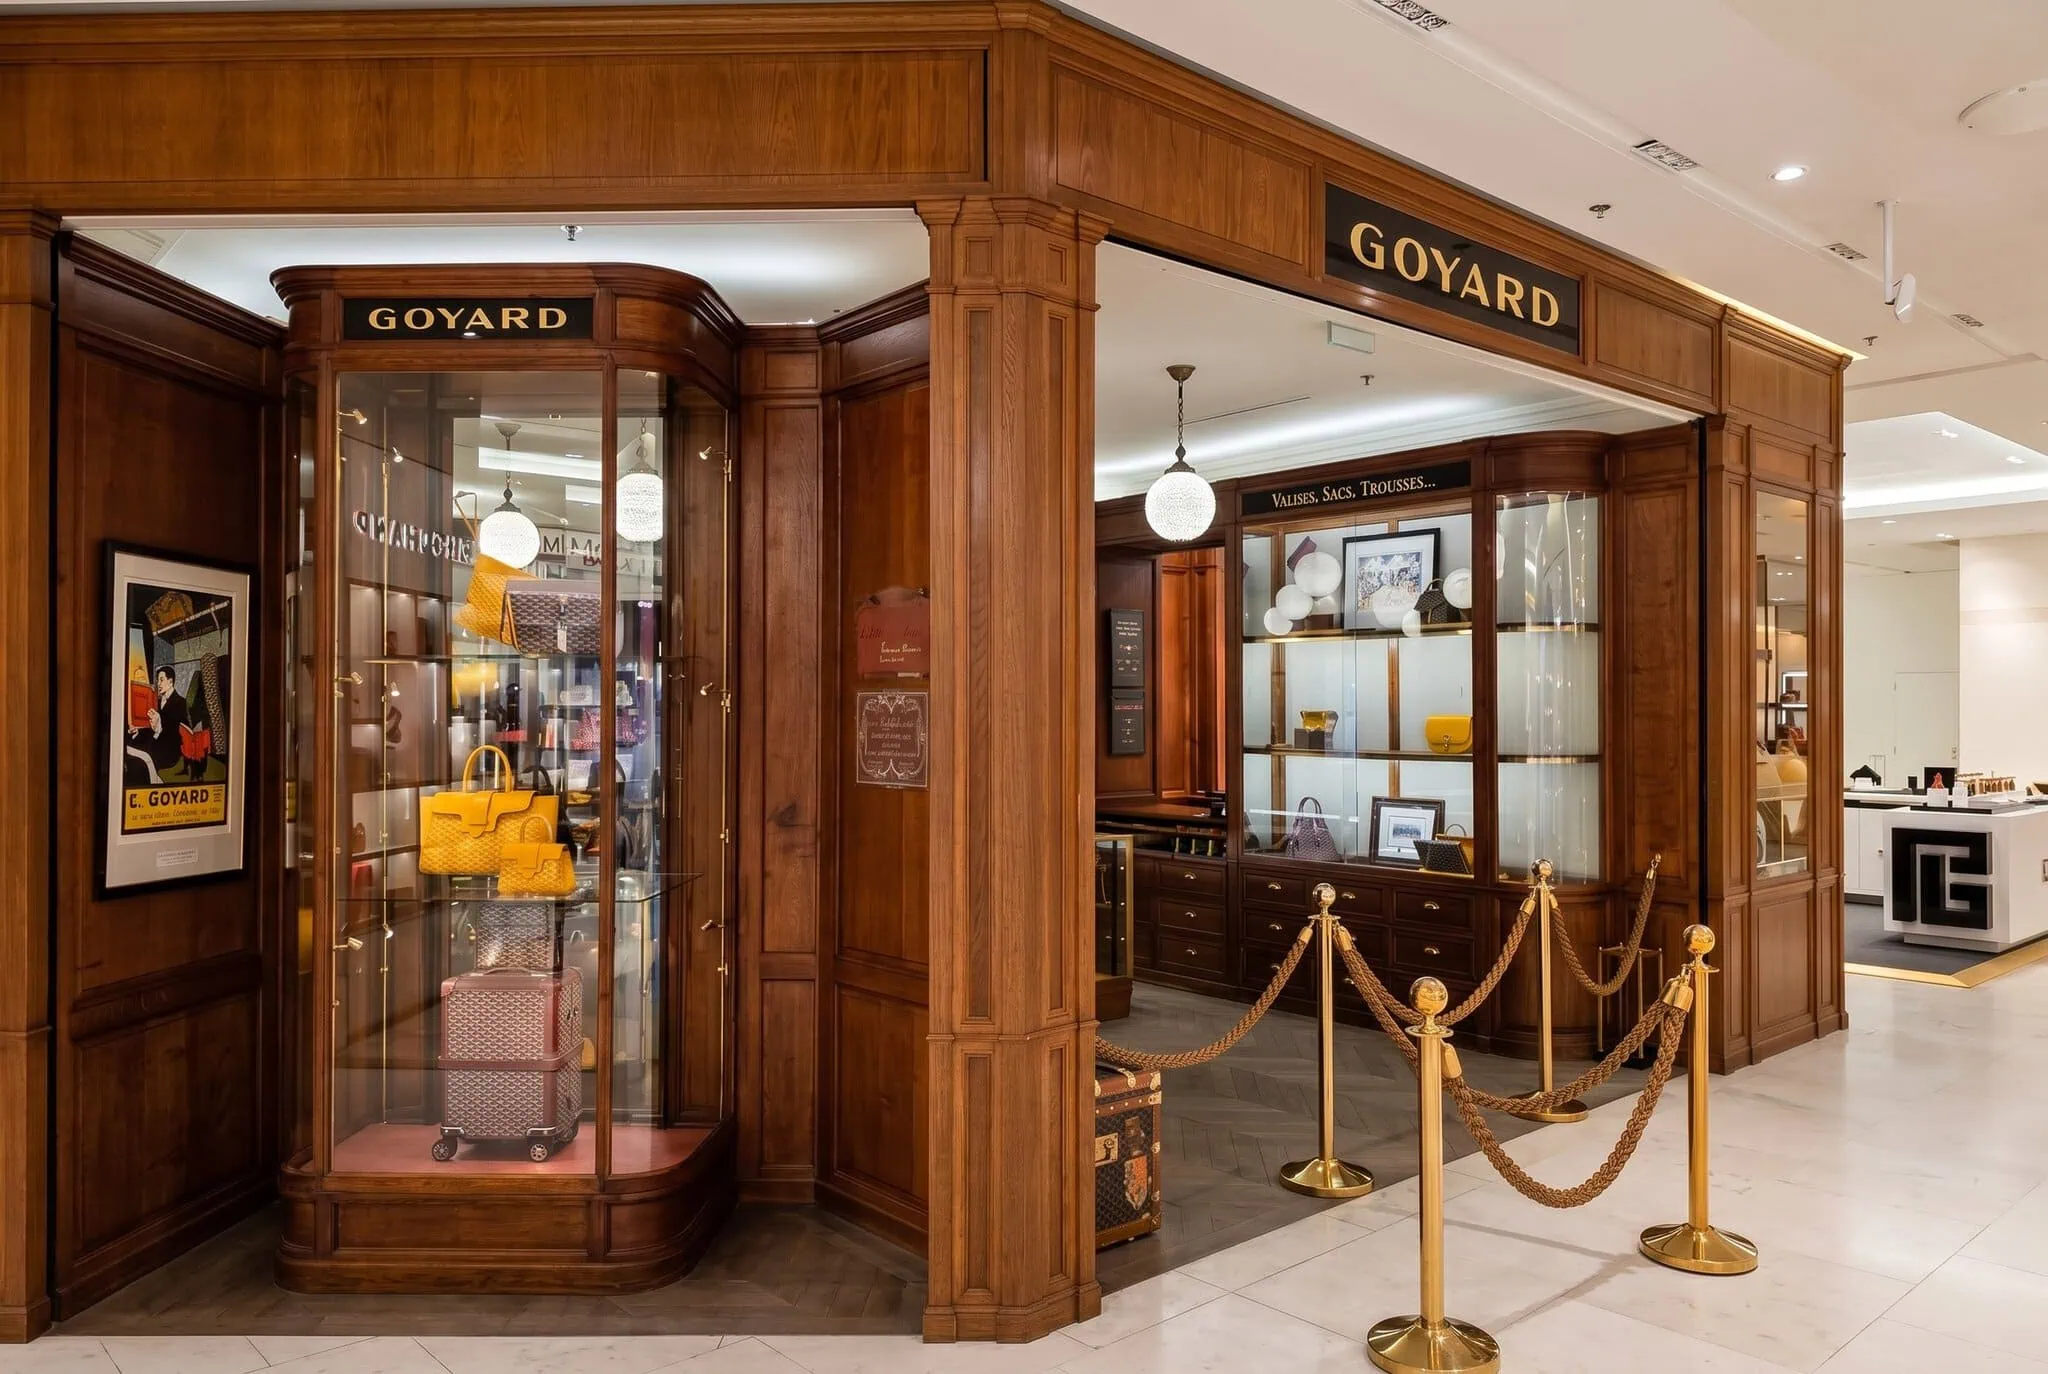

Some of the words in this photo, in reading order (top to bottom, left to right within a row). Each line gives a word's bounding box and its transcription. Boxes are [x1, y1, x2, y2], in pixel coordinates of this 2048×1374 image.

[1350, 222, 1560, 328] GOYARD
[368, 307, 568, 330] GOYARD
[148, 788, 209, 807] GOYARD
